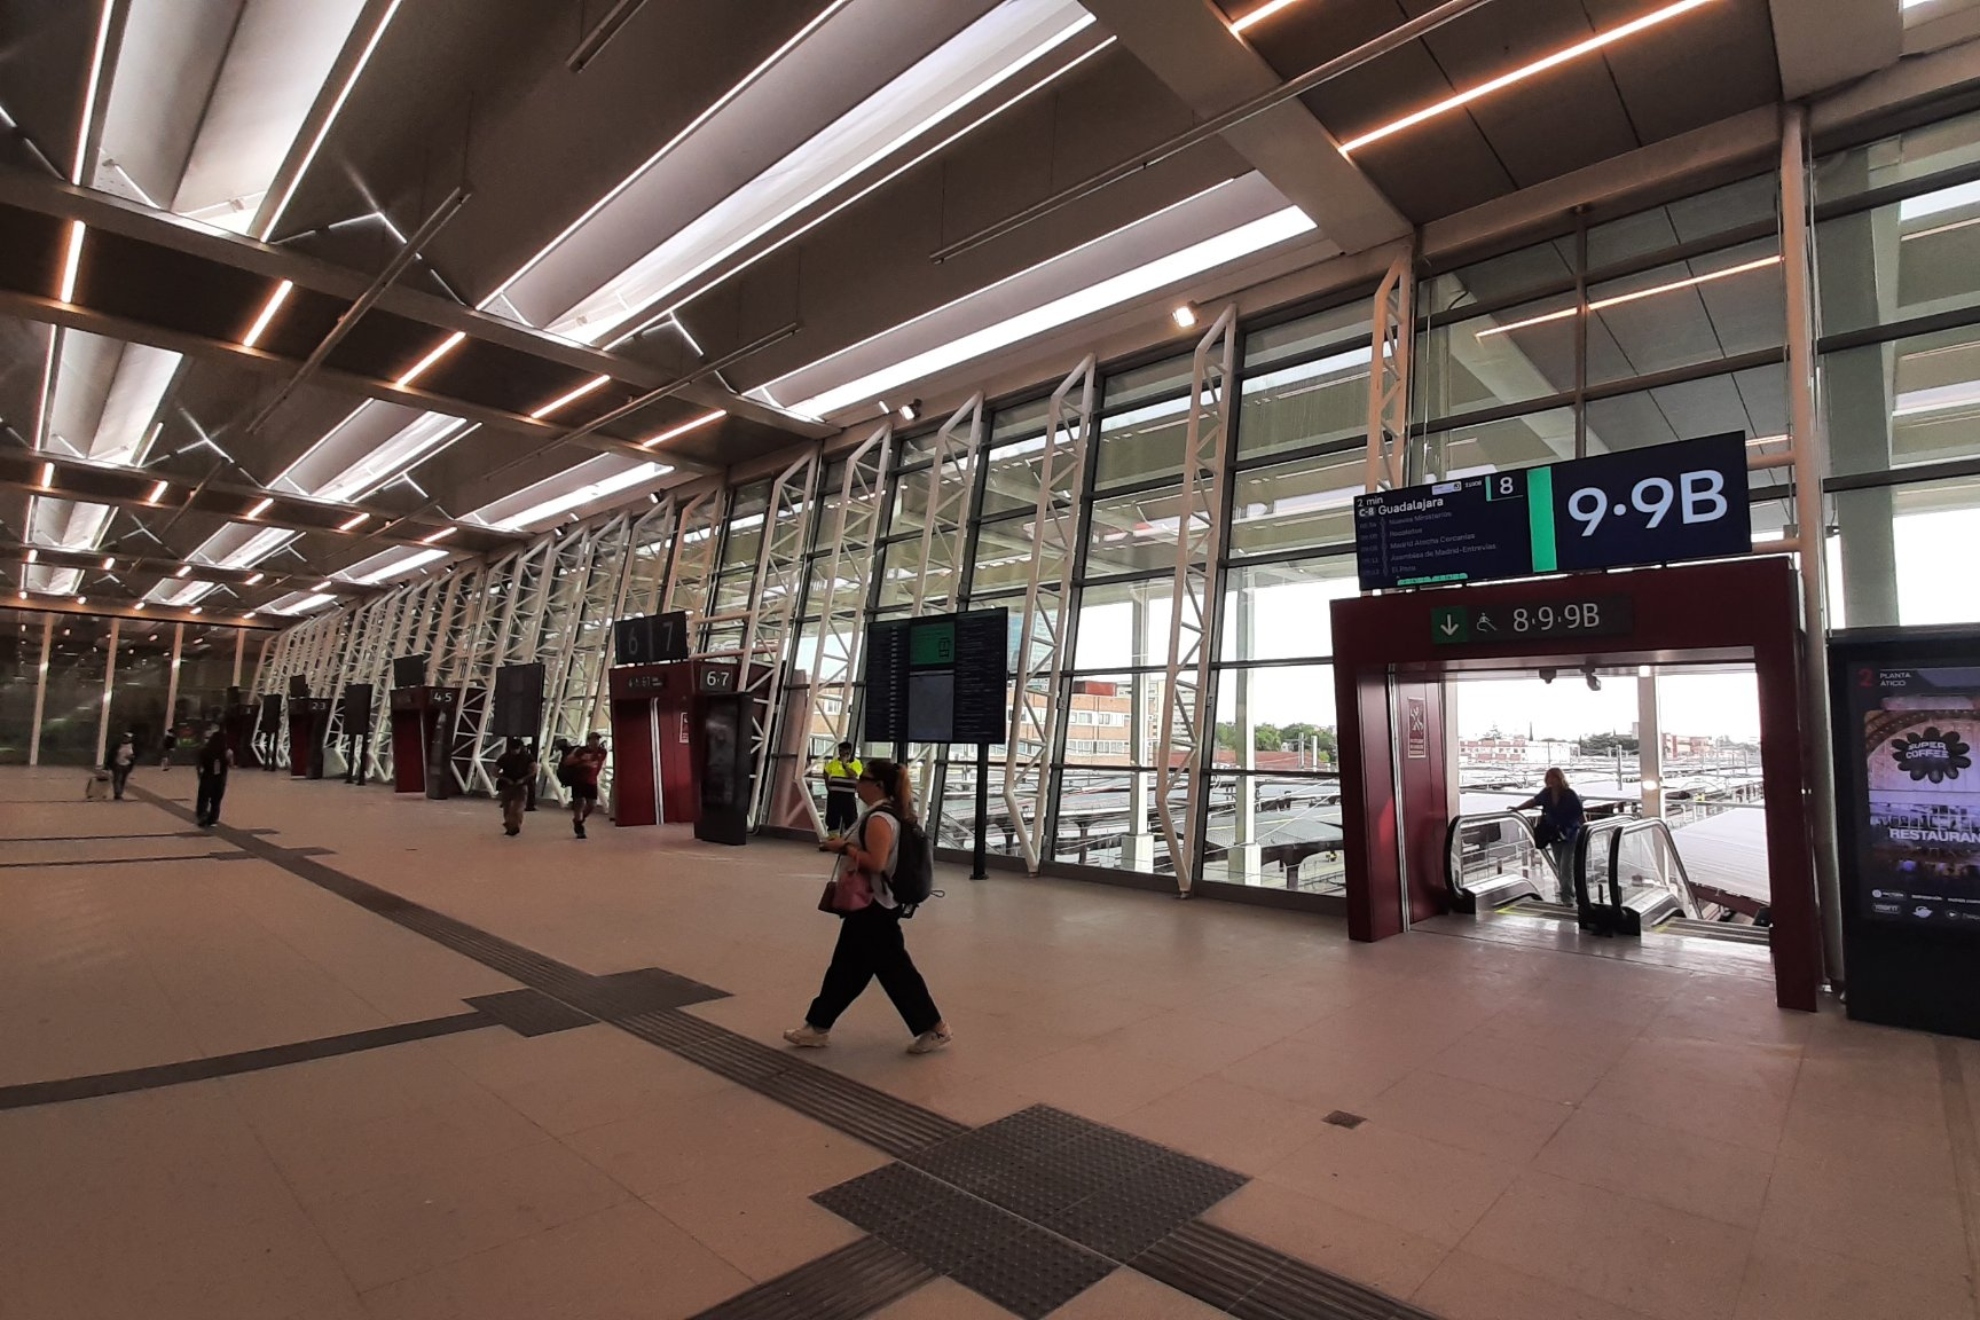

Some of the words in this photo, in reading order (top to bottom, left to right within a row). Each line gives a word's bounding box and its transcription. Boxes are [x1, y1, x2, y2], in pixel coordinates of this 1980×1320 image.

[1500, 476, 1514, 495] 8
[1357, 498, 1364, 507] 2
[1366, 496, 1383, 506] min
[1378, 497, 1444, 516] Guadalajara
[627, 627, 639, 655] 6
[663, 621, 674, 651] 7
[1858, 668, 1875, 687] 2
[1880, 671, 1912, 679] PLANTA
[1905, 749, 1950, 760] COFFEE
[1908, 741, 1947, 751] SUPER
